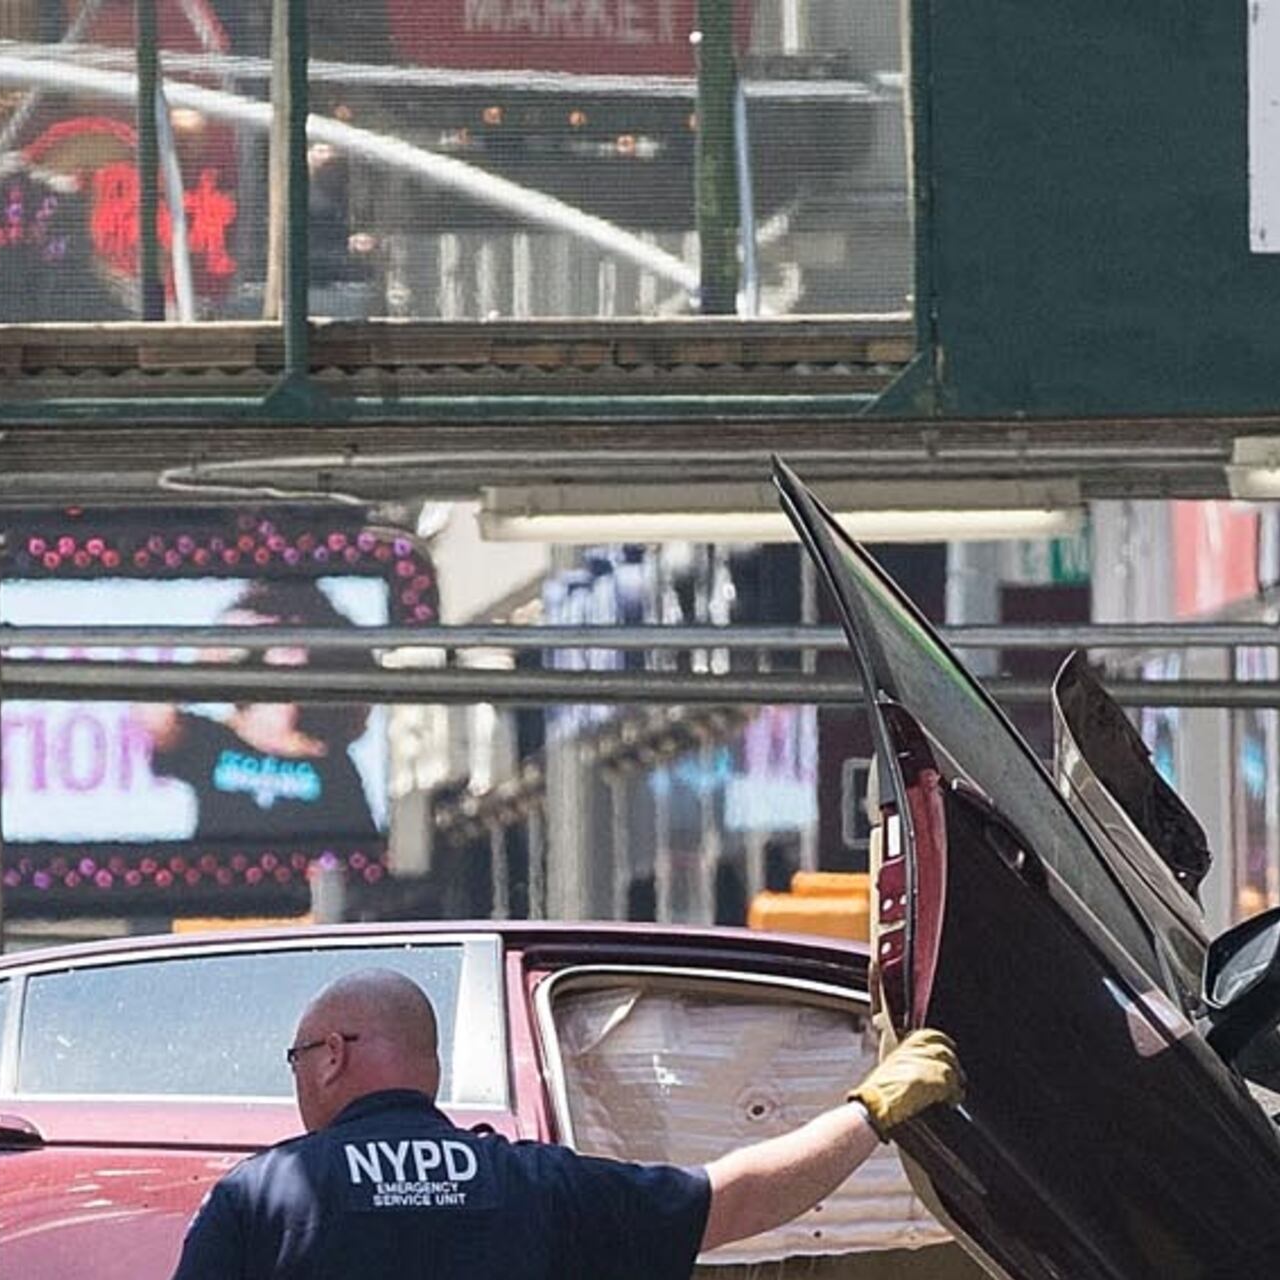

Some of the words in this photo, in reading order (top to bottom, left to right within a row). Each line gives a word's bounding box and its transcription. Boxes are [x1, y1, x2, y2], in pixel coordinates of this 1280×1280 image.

[463, 0, 674, 44] MARKET
[344, 1140, 478, 1183] NYPD
[373, 1194, 431, 1206] SERVICE
[435, 1193, 467, 1206] UNIT
[376, 1182, 458, 1195] EMERGENCY
